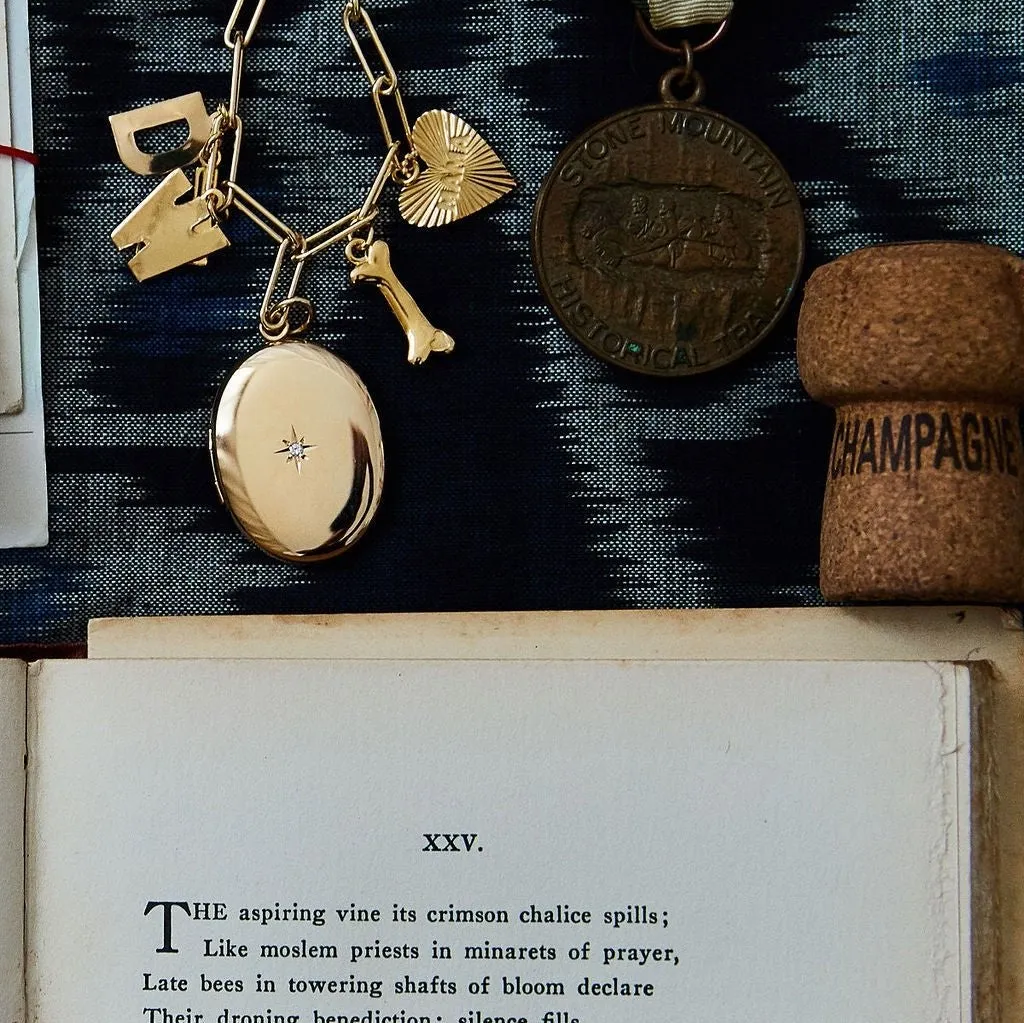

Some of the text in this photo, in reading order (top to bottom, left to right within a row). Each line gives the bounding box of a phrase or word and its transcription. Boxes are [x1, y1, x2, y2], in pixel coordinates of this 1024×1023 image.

[560, 110, 793, 211] STONE MOUNTAIN
[550, 274, 707, 370] HISTORICAL
[829, 411, 1019, 480] CHAMPAGNE
[239, 902, 326, 926] aspiring
[336, 903, 381, 922] vine
[392, 903, 417, 923] its
[427, 904, 509, 923] crimson
[519, 904, 592, 924] chalice
[604, 905, 669, 928] spills;
[203, 939, 680, 966] Like moslem priests in minarets of prayer,
[142, 973, 655, 998] Late bees in towering shafts of bloom declare
[143, 1007, 204, 1023] Their
[217, 1009, 300, 1023] droning
